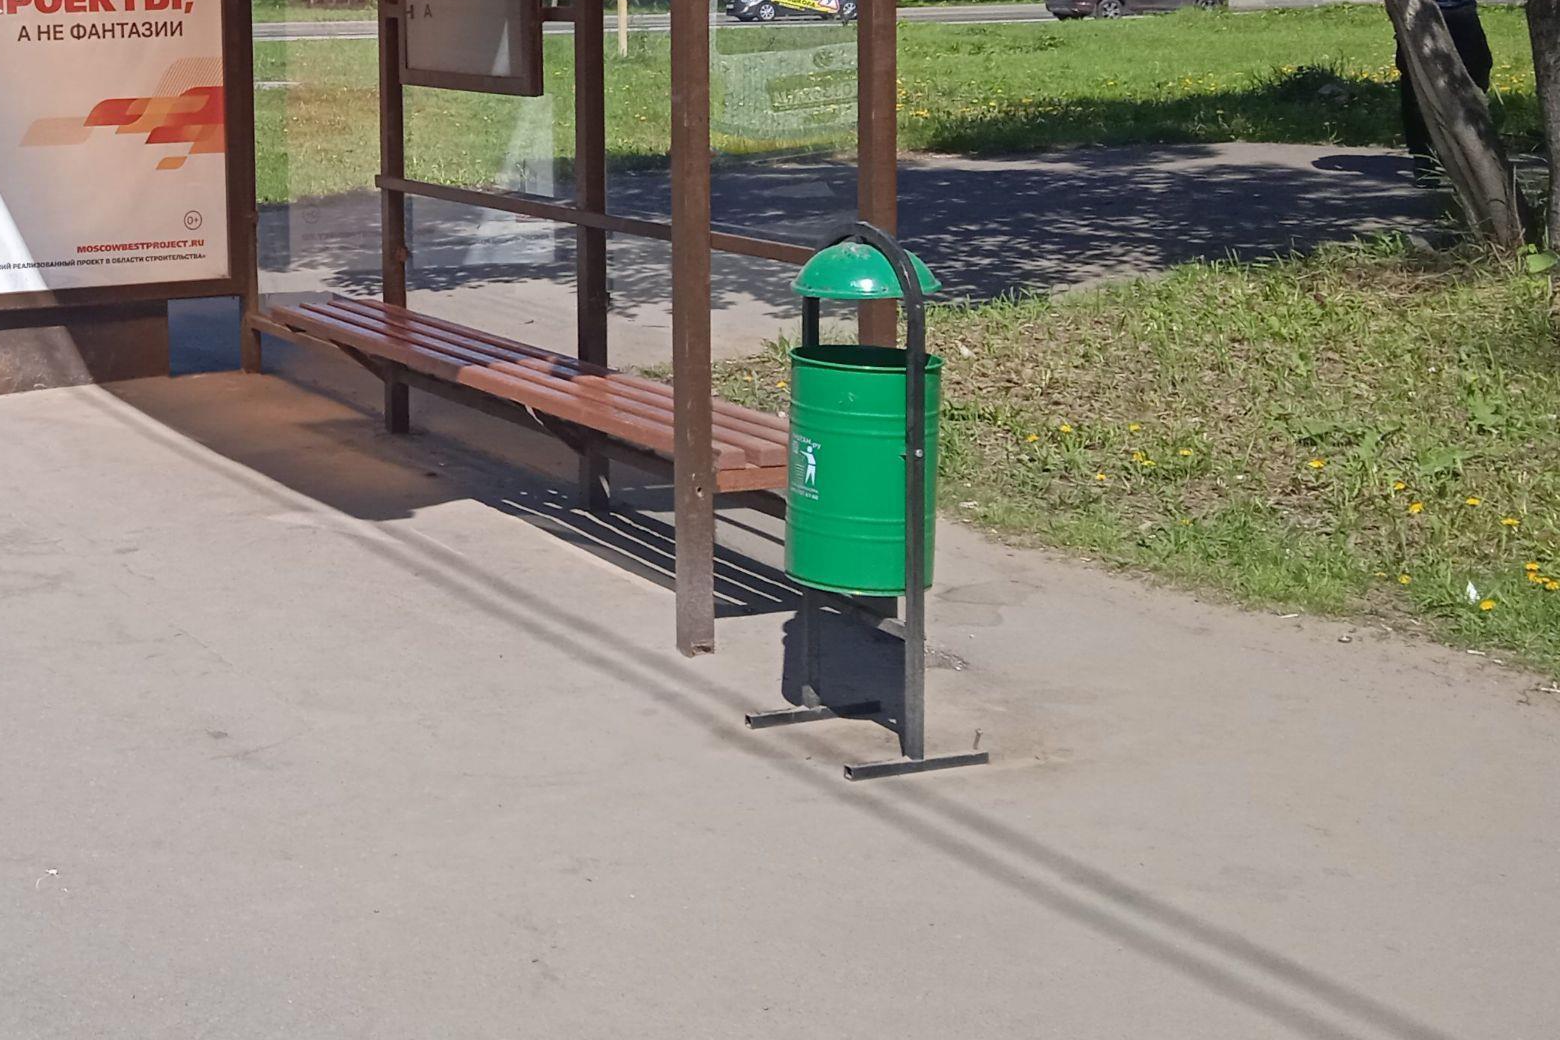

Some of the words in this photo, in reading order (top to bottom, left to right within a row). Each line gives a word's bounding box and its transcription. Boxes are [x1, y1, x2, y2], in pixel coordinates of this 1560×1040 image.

[17, 25, 31, 42] А
[37, 24, 64, 41] НЕ
[70, 21, 184, 41] ФАНТАЗИИ
[186, 215, 200, 226] 0+
[76, 239, 205, 254] MOSCOWBESTPROJECT.RU
[12, 259, 76, 270] РЕАЛИЗОВАННЫЙ
[76, 258, 104, 266] ПРОЕКТ
[105, 257, 111, 265] В
[111, 255, 144, 264] ОБЛАСТИ
[145, 252, 207, 262] СТРОИТЕЛЬСТВА»
